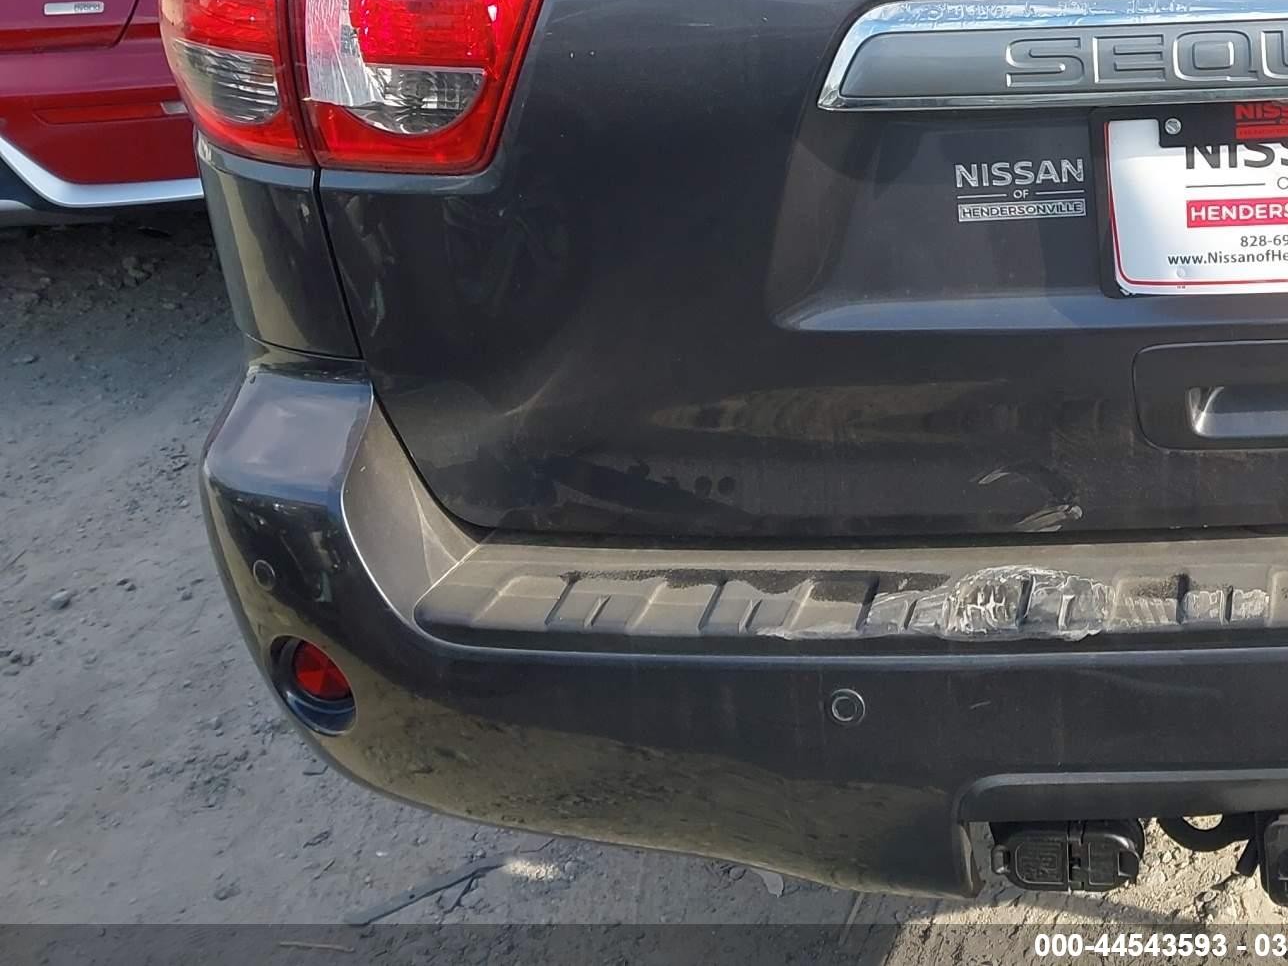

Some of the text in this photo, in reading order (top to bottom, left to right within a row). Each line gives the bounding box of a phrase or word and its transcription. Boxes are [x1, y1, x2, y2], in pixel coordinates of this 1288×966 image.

[955, 159, 1084, 188] NISSAN
[1013, 189, 1029, 199] OF
[961, 201, 1083, 218] HENDERSONVILLE
